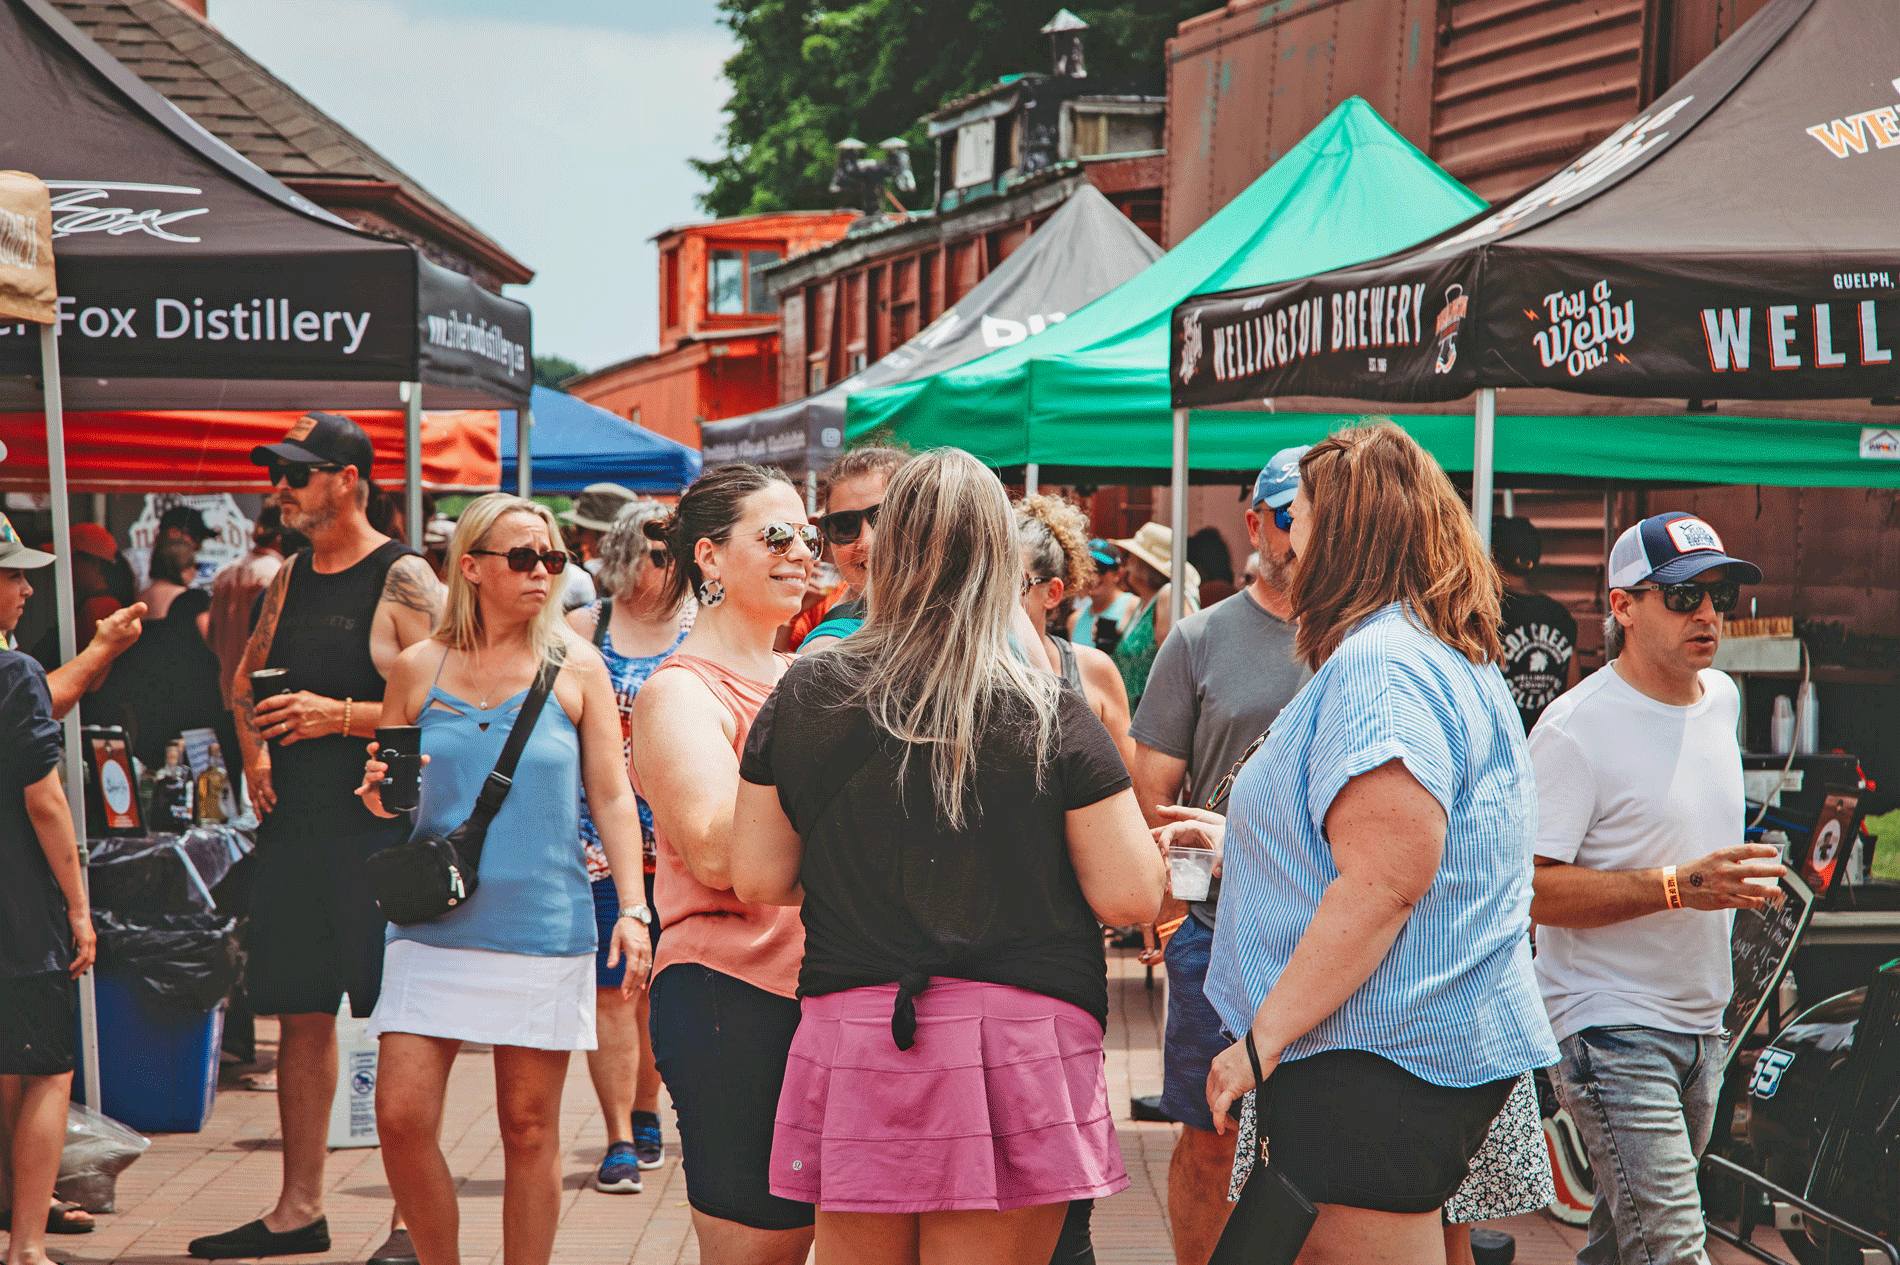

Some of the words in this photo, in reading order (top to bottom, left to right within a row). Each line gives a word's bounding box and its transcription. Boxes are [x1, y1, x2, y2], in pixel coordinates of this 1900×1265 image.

[1543, 289, 1586, 324] Try
[1592, 279, 1612, 303] a
[1832, 271, 1895, 290] GUELPH,
[56, 296, 137, 338] Fox
[156, 297, 372, 354] Distillery
[1212, 295, 1323, 383] WELLINGTON
[1330, 283, 1427, 352] BREWERY
[1532, 299, 1635, 368] Welly
[1700, 300, 1892, 373] WELL
[1567, 341, 1609, 377] On!
